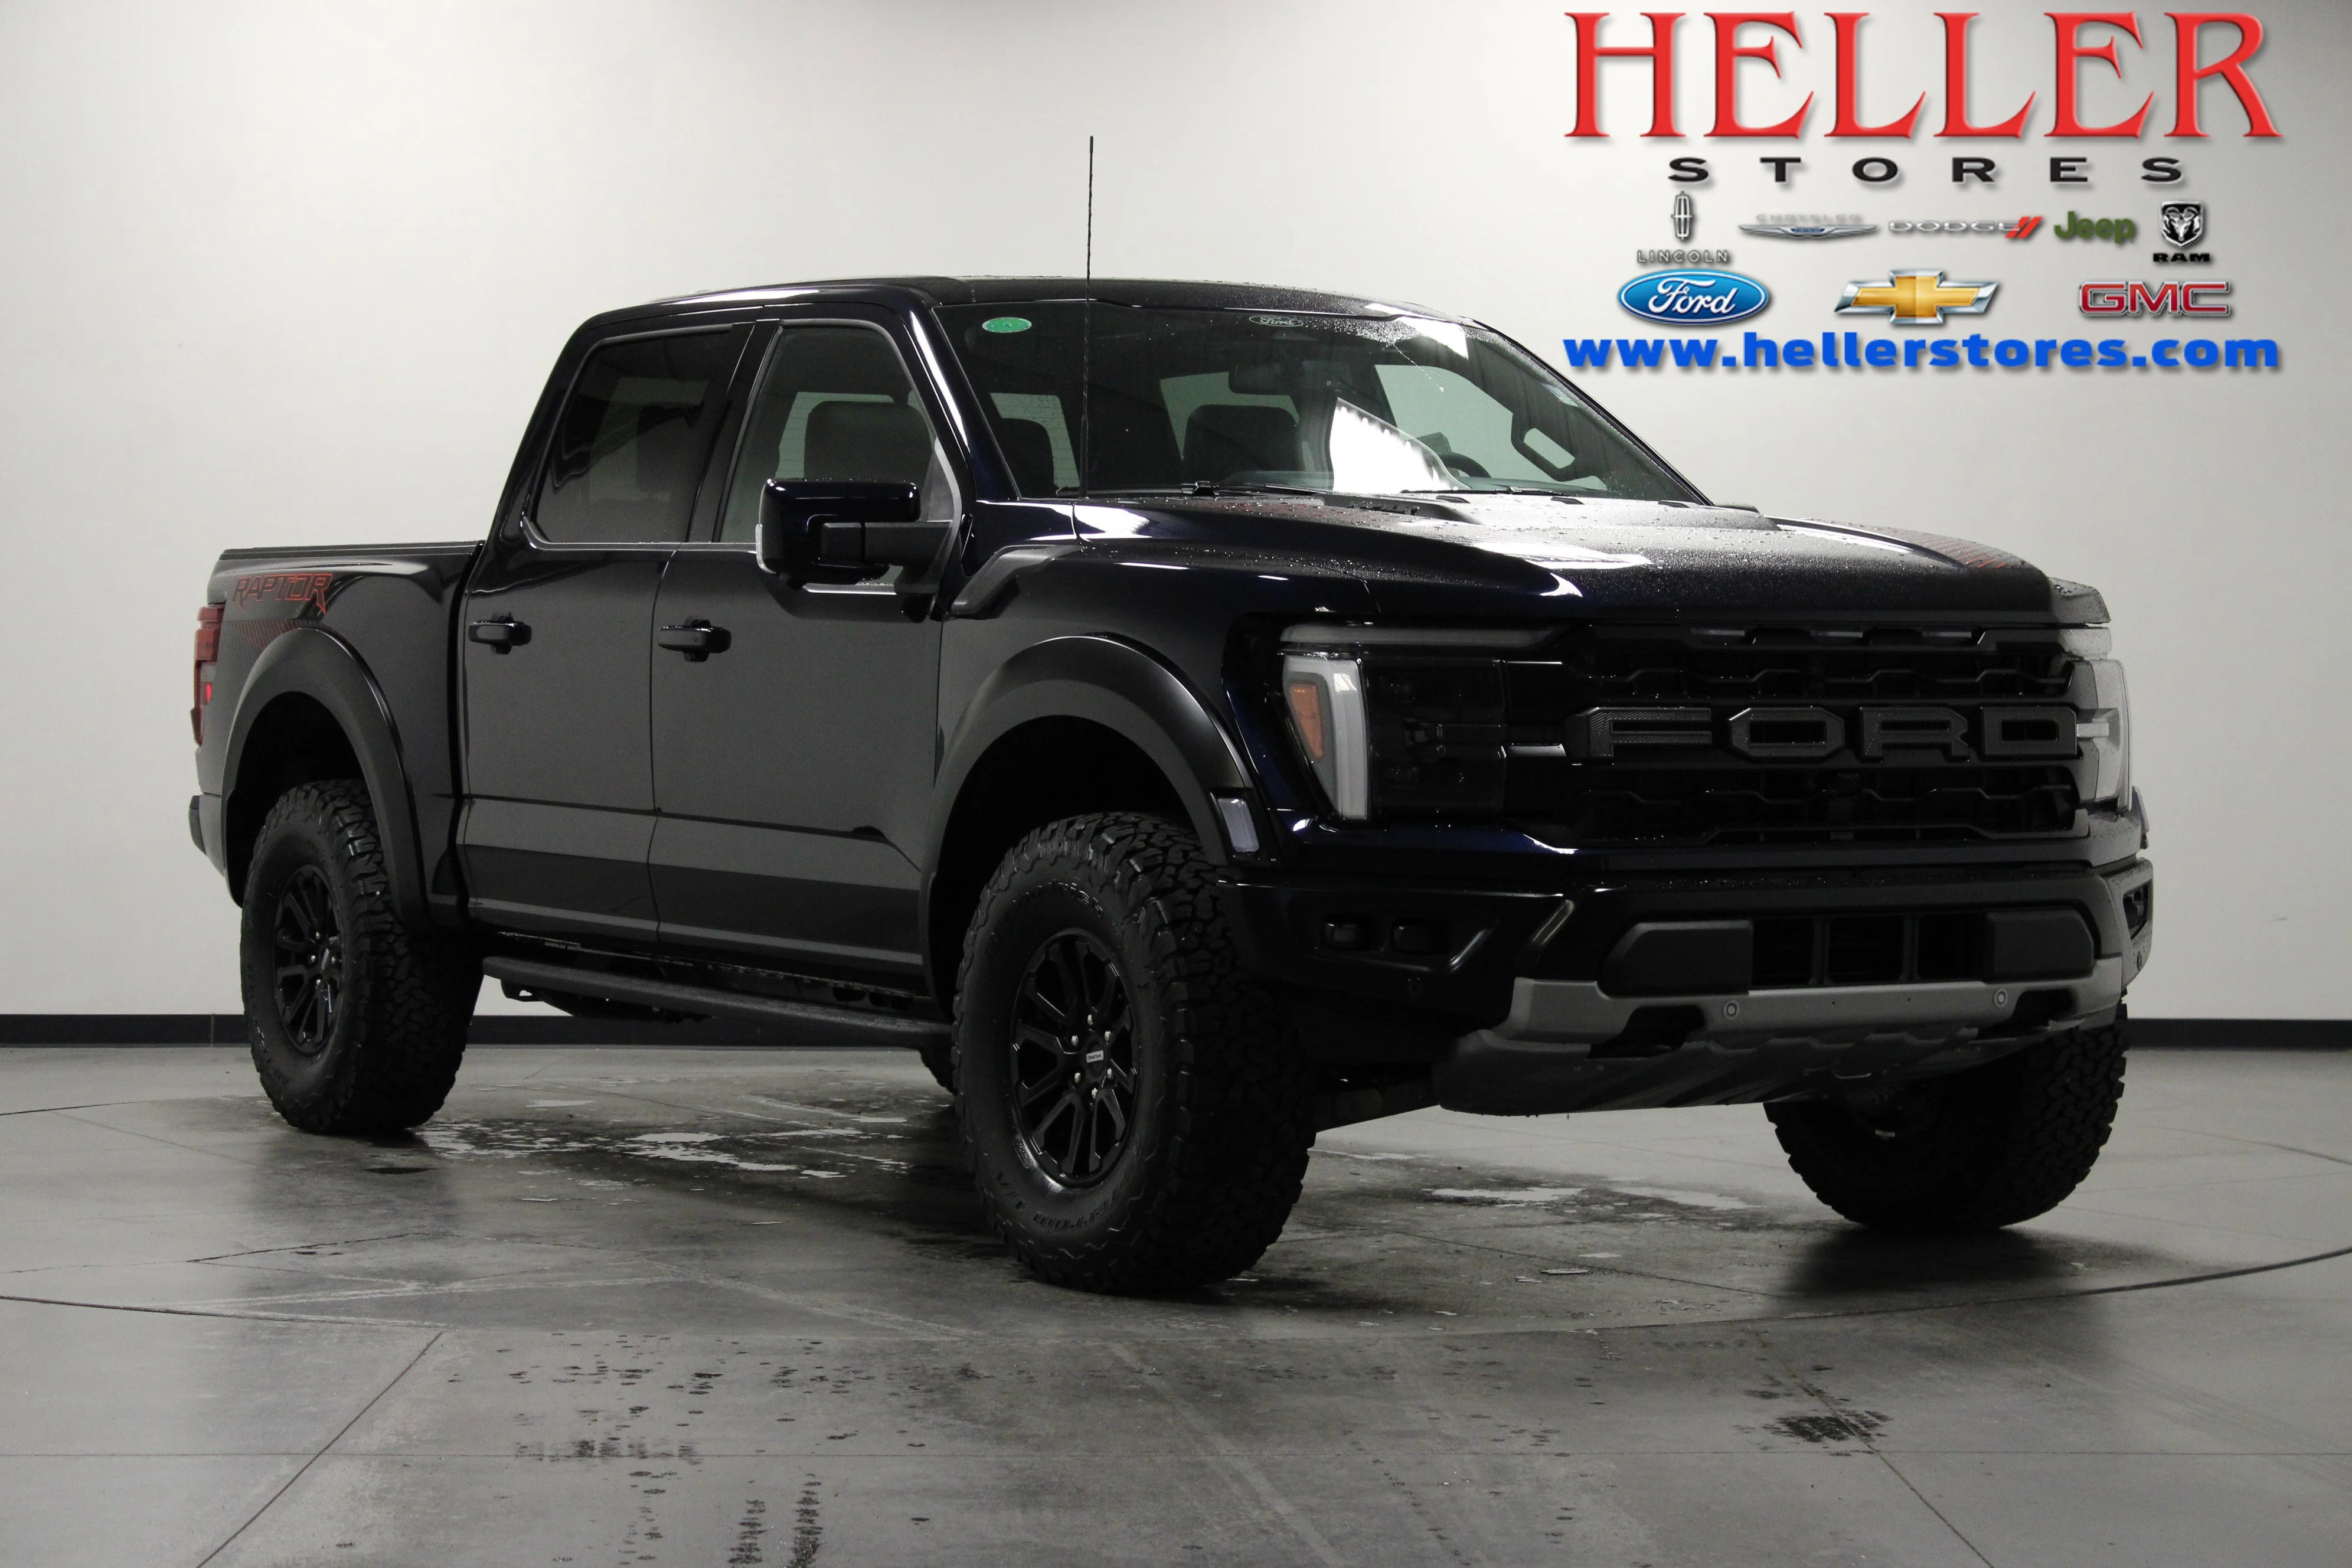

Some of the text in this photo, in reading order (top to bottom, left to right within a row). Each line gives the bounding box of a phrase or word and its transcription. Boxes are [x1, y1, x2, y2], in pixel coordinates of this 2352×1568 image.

[1259, 316, 1295, 326] Ford
[232, 573, 333, 614] RAPTOR
[1567, 704, 2079, 760] FORD
